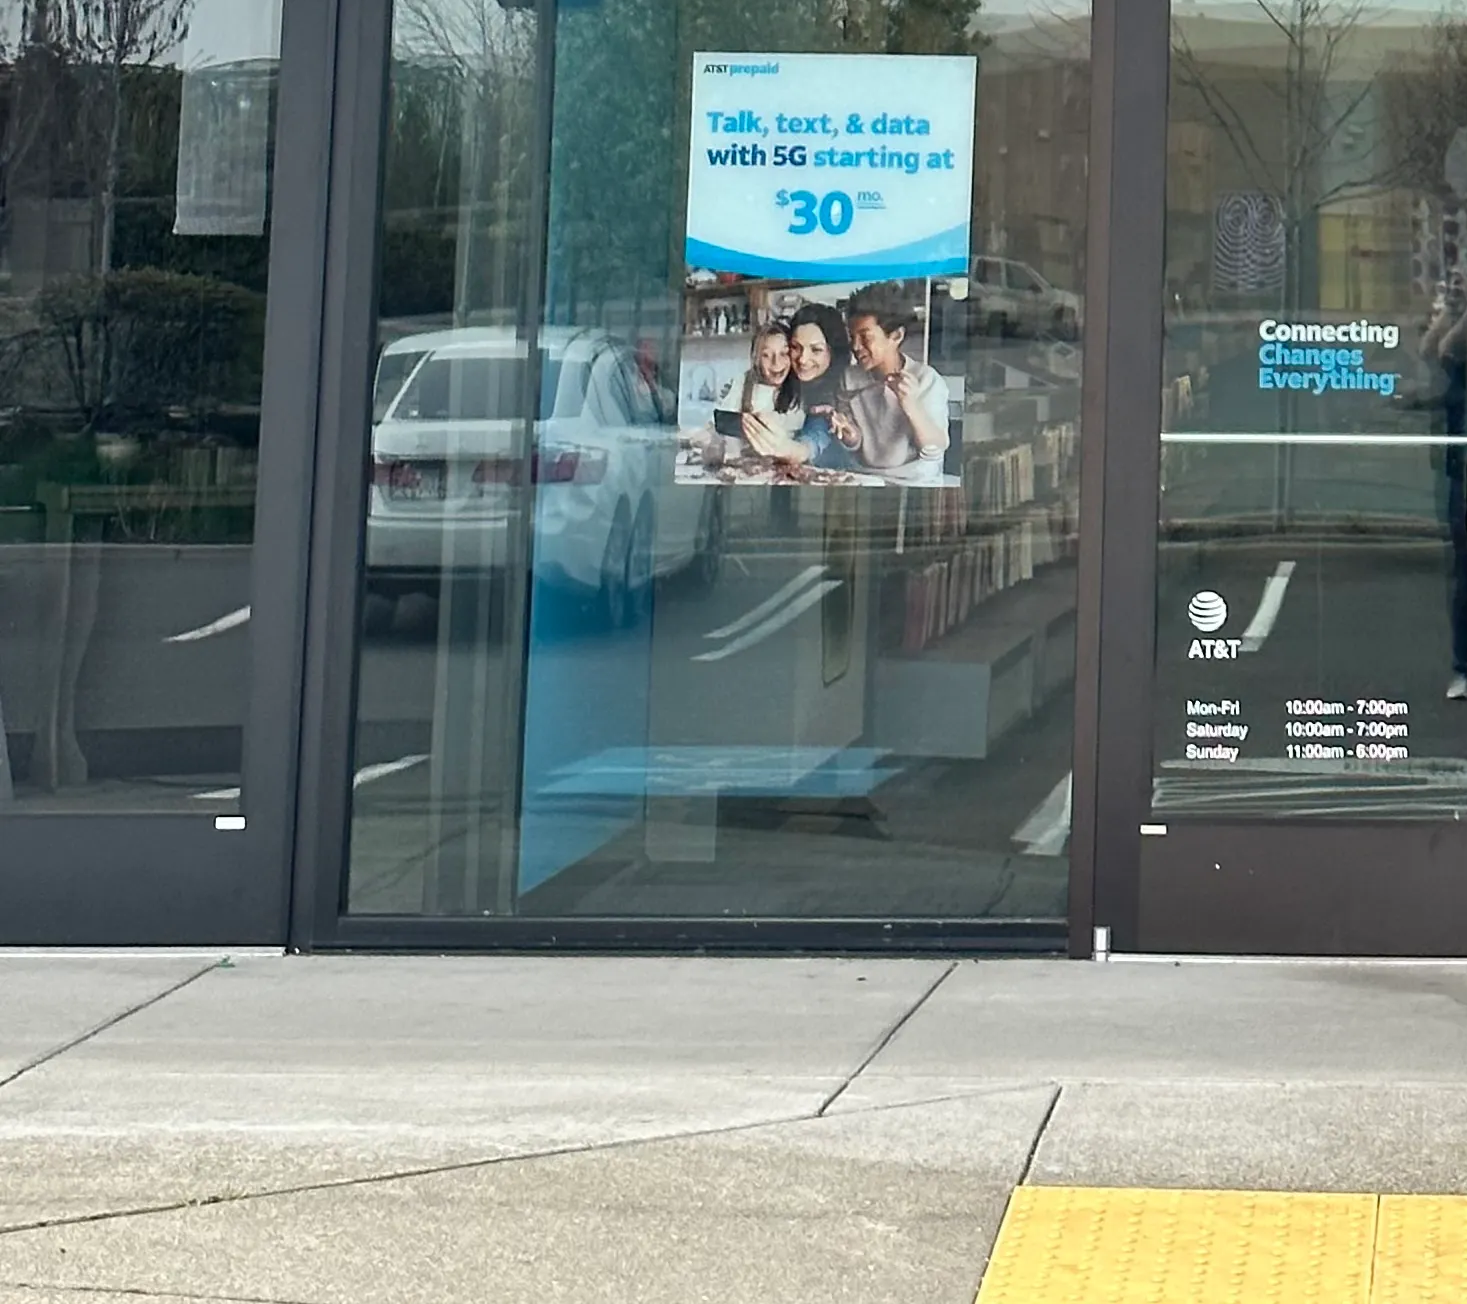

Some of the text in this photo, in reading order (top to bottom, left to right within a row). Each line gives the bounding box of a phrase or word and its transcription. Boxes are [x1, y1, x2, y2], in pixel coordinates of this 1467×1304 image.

[729, 62, 780, 78] prepaid
[706, 111, 931, 138] Talk, text, & data
[706, 143, 955, 174] with 5G starting at
[775, 189, 854, 236] $30
[1259, 319, 1399, 349] Connecting
[1259, 343, 1364, 372] Changes
[1259, 367, 1396, 396] Everything
[1188, 639, 1242, 659] AT&T
[1186, 699, 1240, 716] Mon-Fri
[1285, 699, 1345, 716] 10:00am
[1356, 699, 1408, 718] 7:00pm
[1186, 722, 1249, 741] Saturday
[1285, 722, 1345, 738] 10:00am
[1356, 722, 1408, 740] 7:00pm
[1186, 744, 1239, 763] Sunday
[1285, 744, 1345, 760] 11:00am
[1356, 744, 1408, 762] 6:00pm
